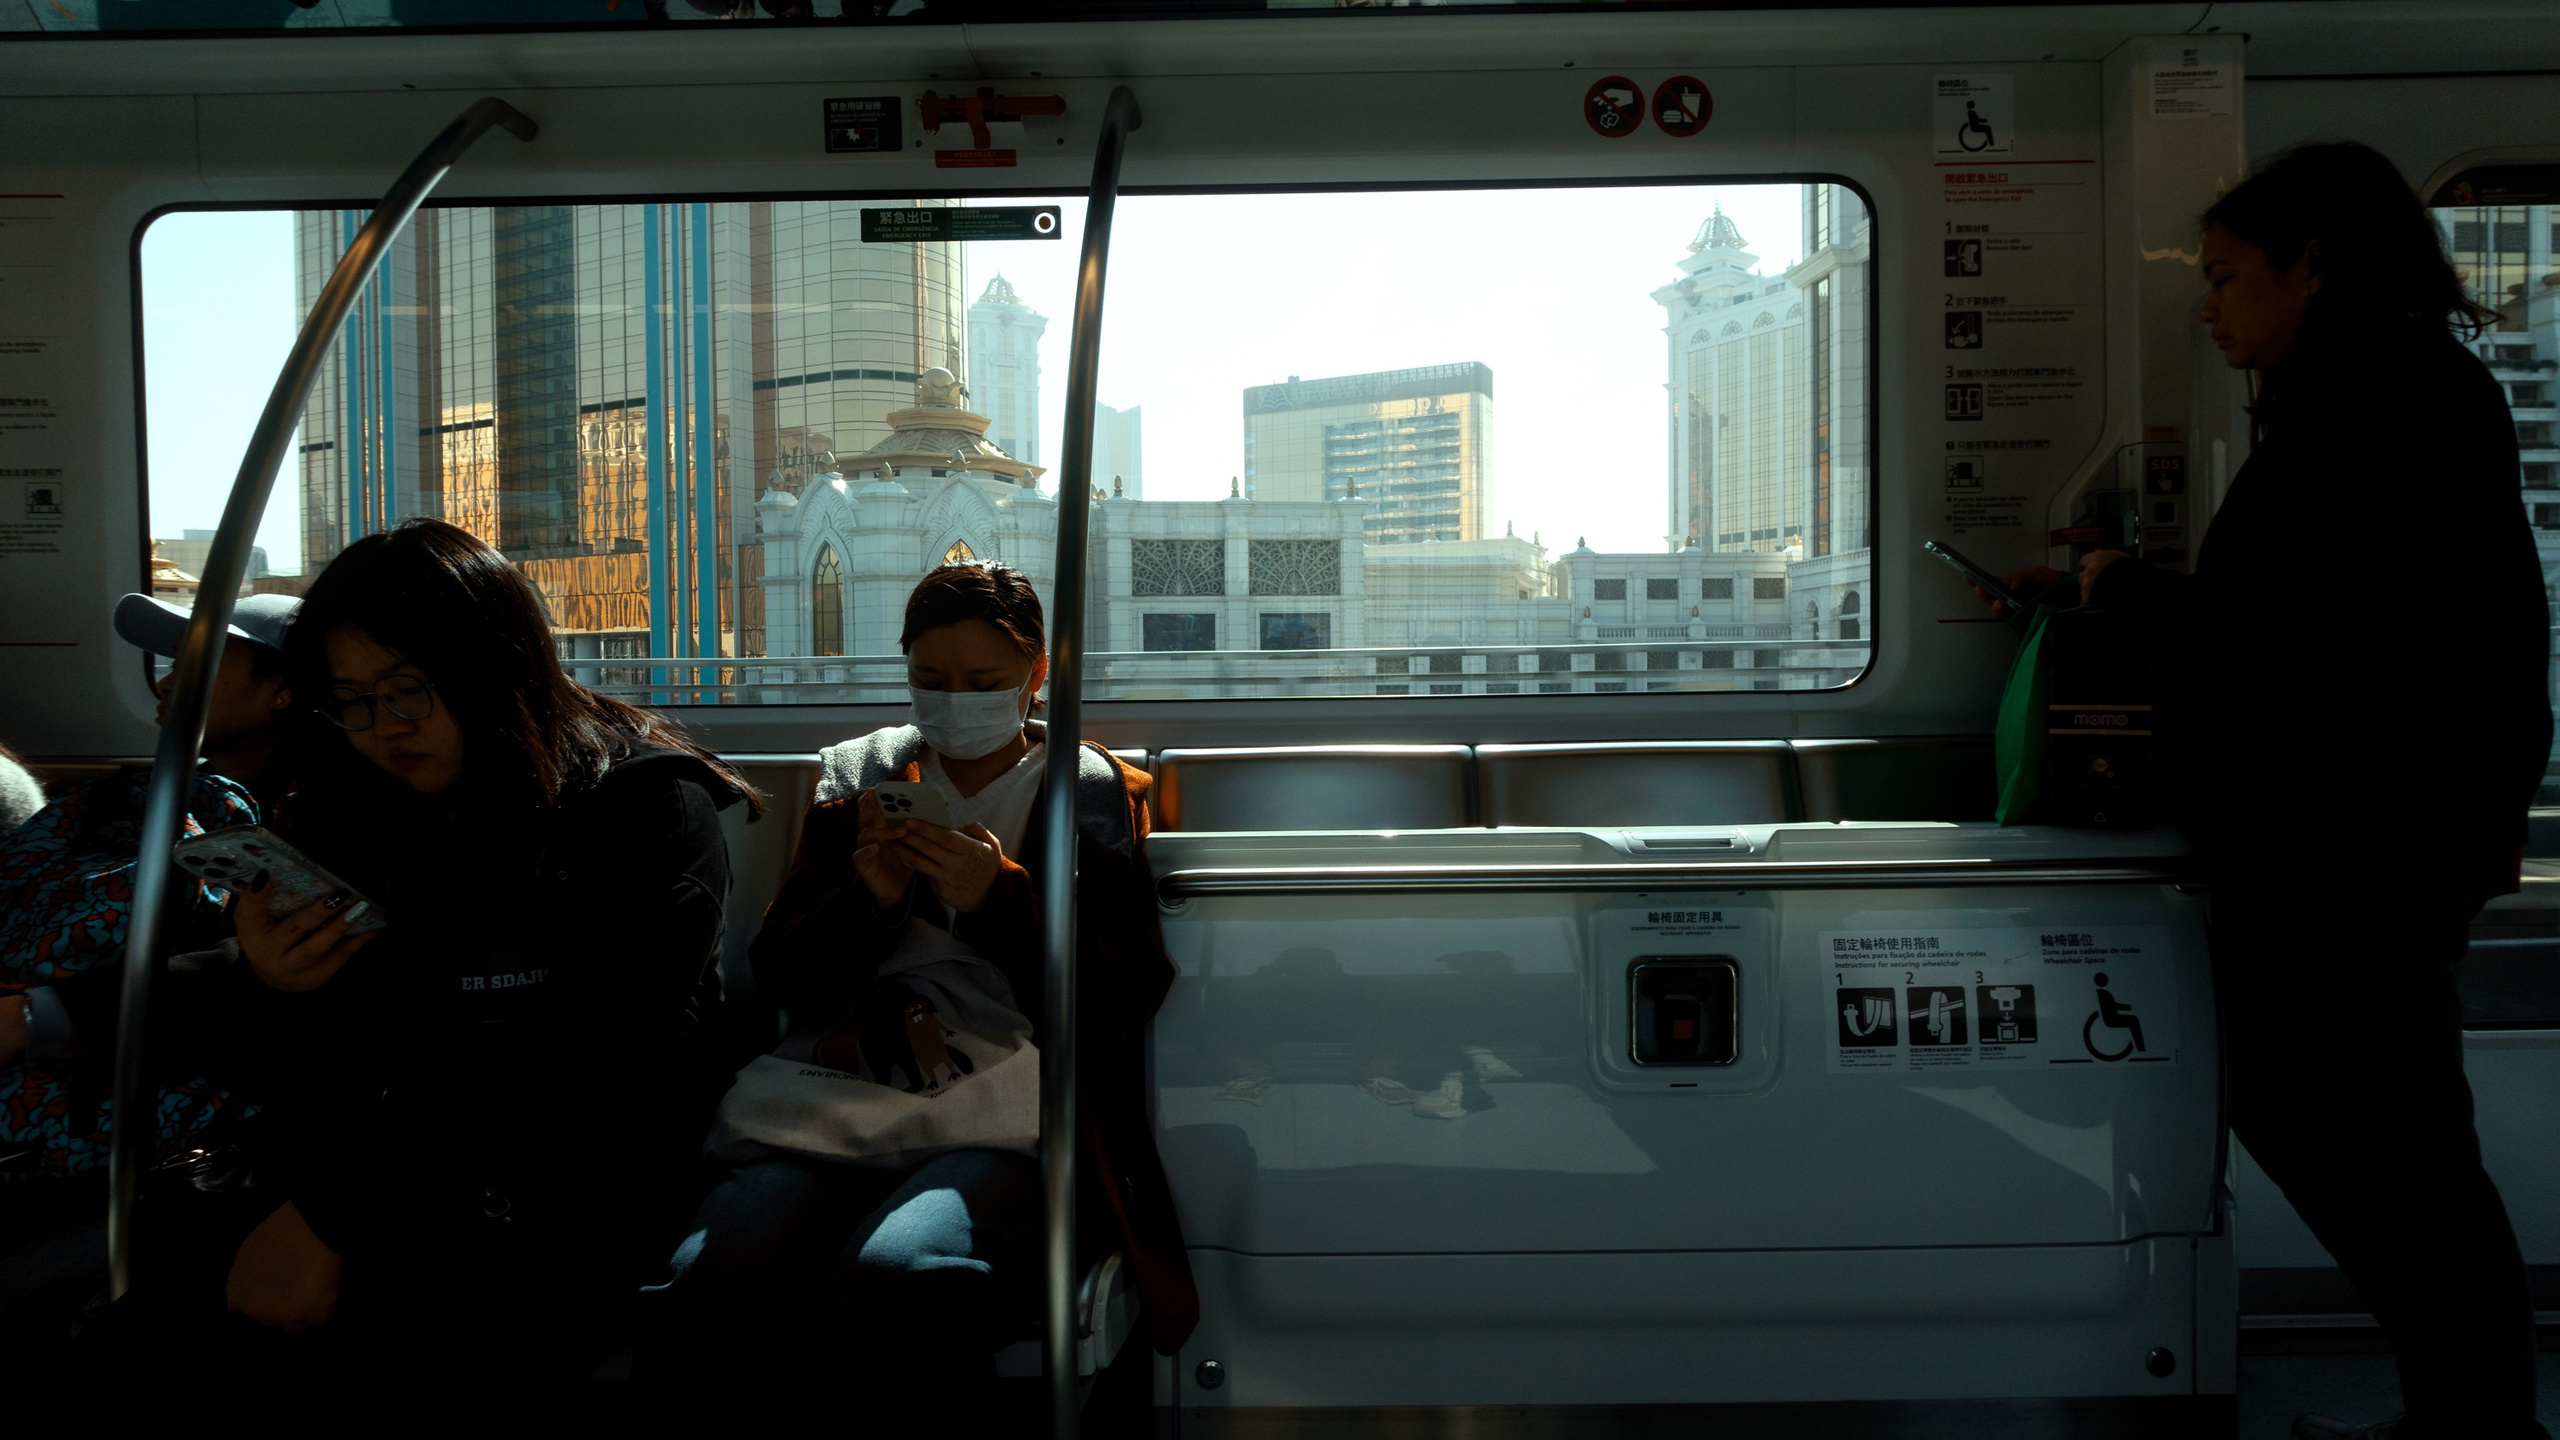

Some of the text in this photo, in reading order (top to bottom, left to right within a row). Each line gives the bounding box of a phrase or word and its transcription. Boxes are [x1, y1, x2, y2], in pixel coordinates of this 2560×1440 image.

[880, 211, 932, 224] 緊急出口
[1945, 221, 1952, 234] 1
[1945, 294, 1953, 306] 2
[1945, 365, 1954, 378] 3
[2151, 459, 2180, 470] SOS
[1648, 911, 1723, 924] 輪椅固定用具
[1833, 937, 1940, 951] 固定輪椅使用指南
[2041, 934, 2094, 947] 輪椅區位
[1834, 952, 1870, 960] Instruções
[1890, 951, 1915, 959] fixação
[1890, 961, 1920, 969] securing
[1836, 973, 1843, 986] 1
[1905, 971, 1914, 985] 2
[1975, 971, 1984, 984] 3
